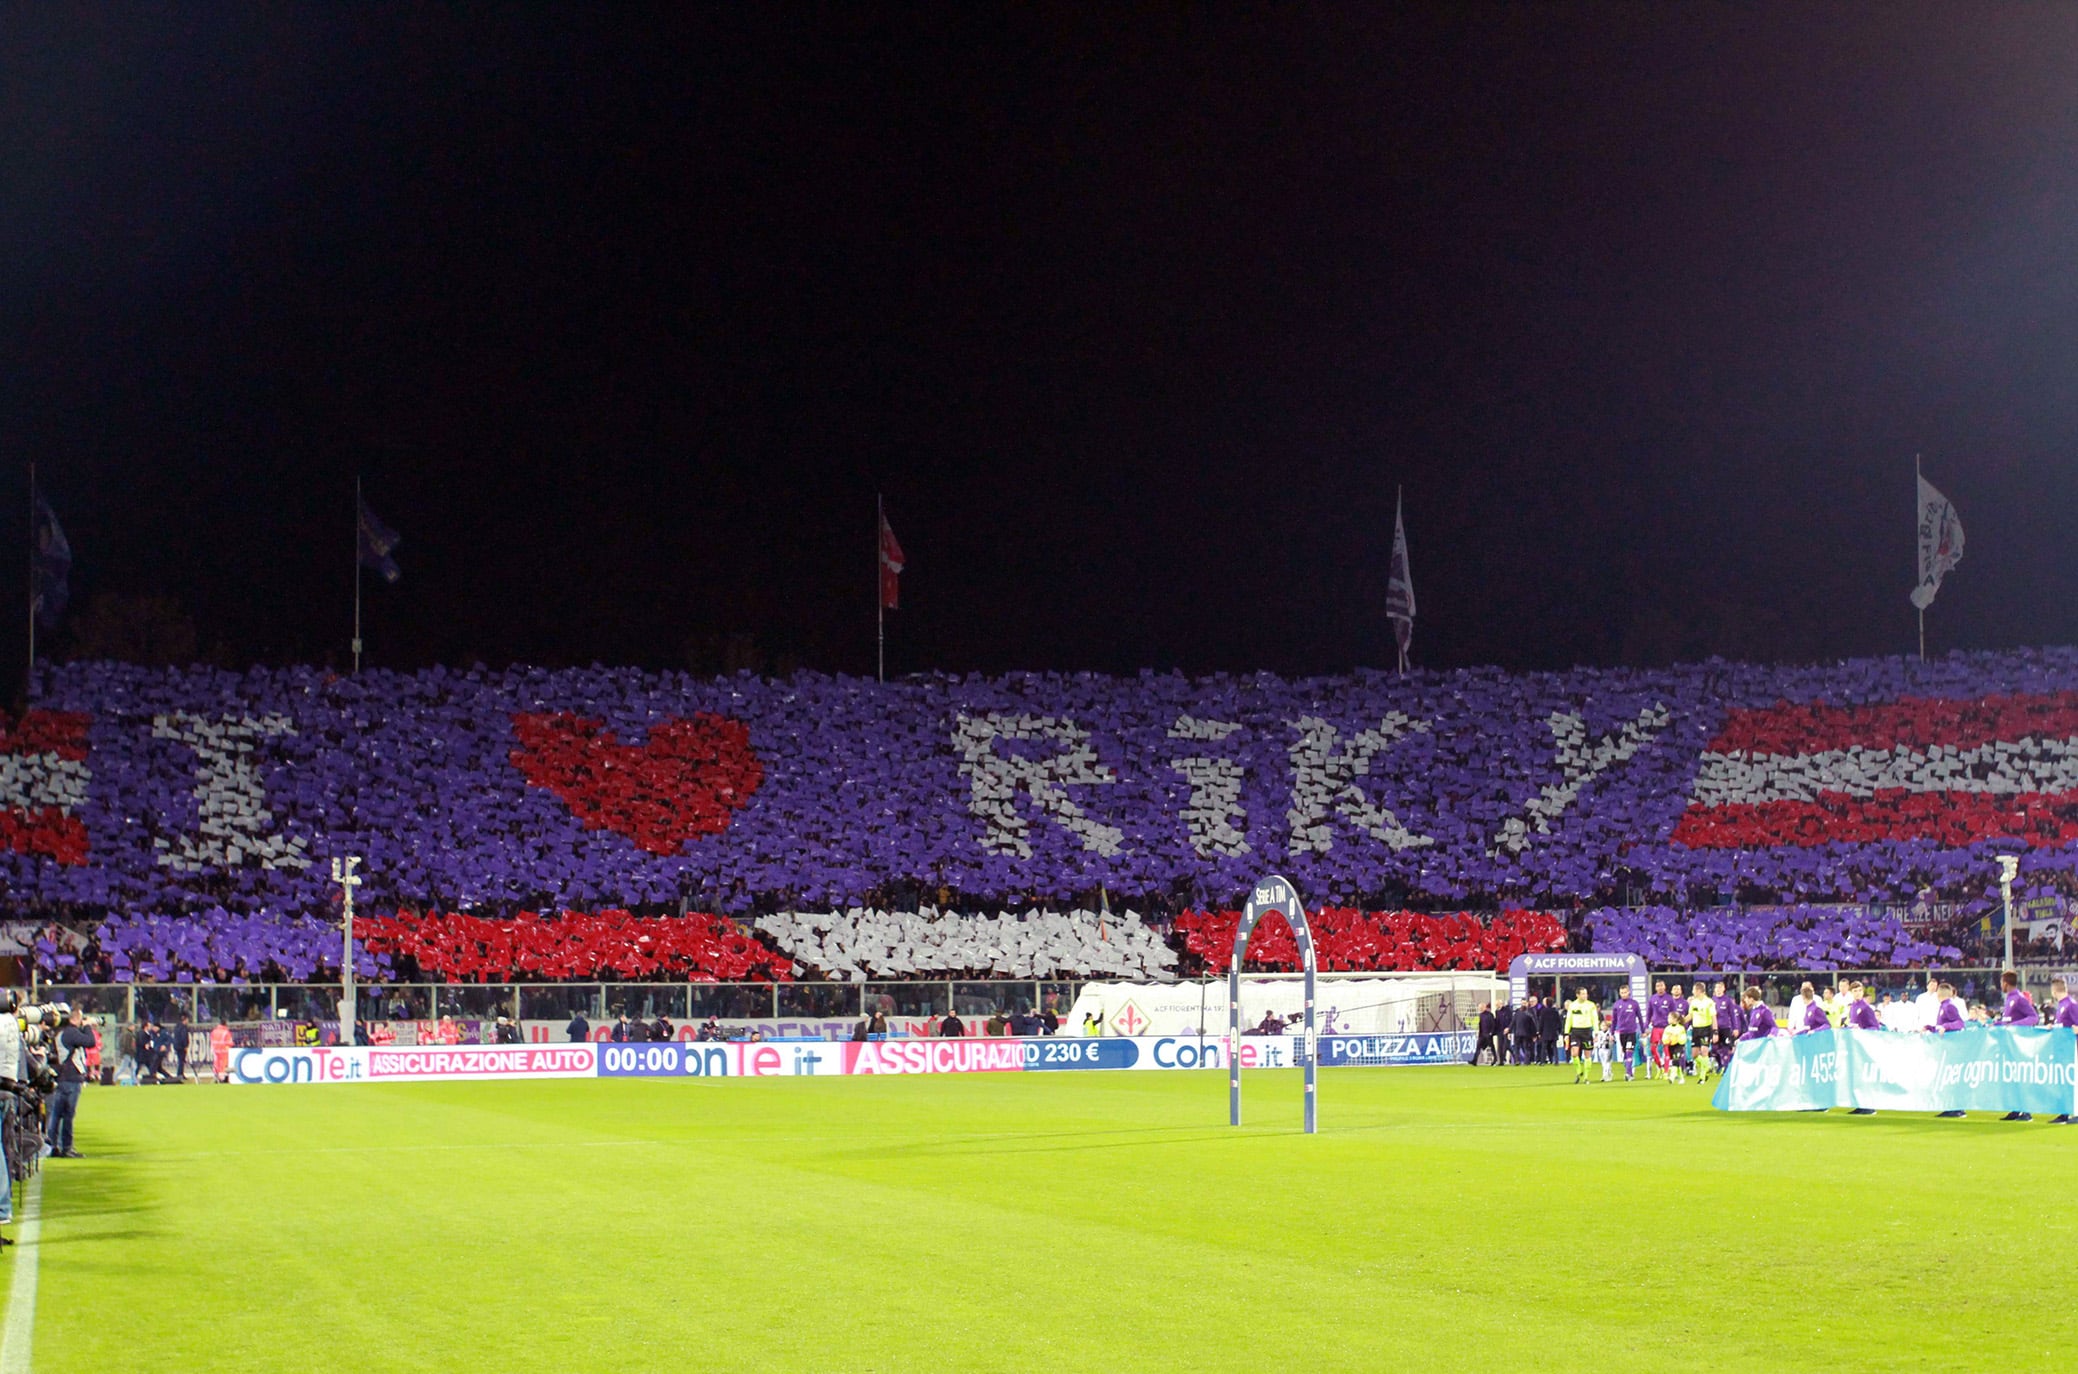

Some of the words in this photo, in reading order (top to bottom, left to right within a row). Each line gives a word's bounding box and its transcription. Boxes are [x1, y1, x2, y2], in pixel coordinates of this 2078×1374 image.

[1534, 958, 1556, 969] ACF
[1558, 957, 1625, 969] FIORENTINA
[1045, 1043, 1081, 1063] 230
[1085, 1042, 1100, 1062] €
[1331, 1038, 1421, 1059] POLIZZA
[1425, 1036, 1461, 1056] AUTO
[234, 1048, 363, 1084] ConTe.it
[372, 1051, 529, 1074] ASSICURAZIONE
[531, 1051, 590, 1071] AUTO
[605, 1047, 679, 1072] 00:00
[1941, 1062, 1964, 1091] per
[1964, 1053, 1999, 1088] ogni
